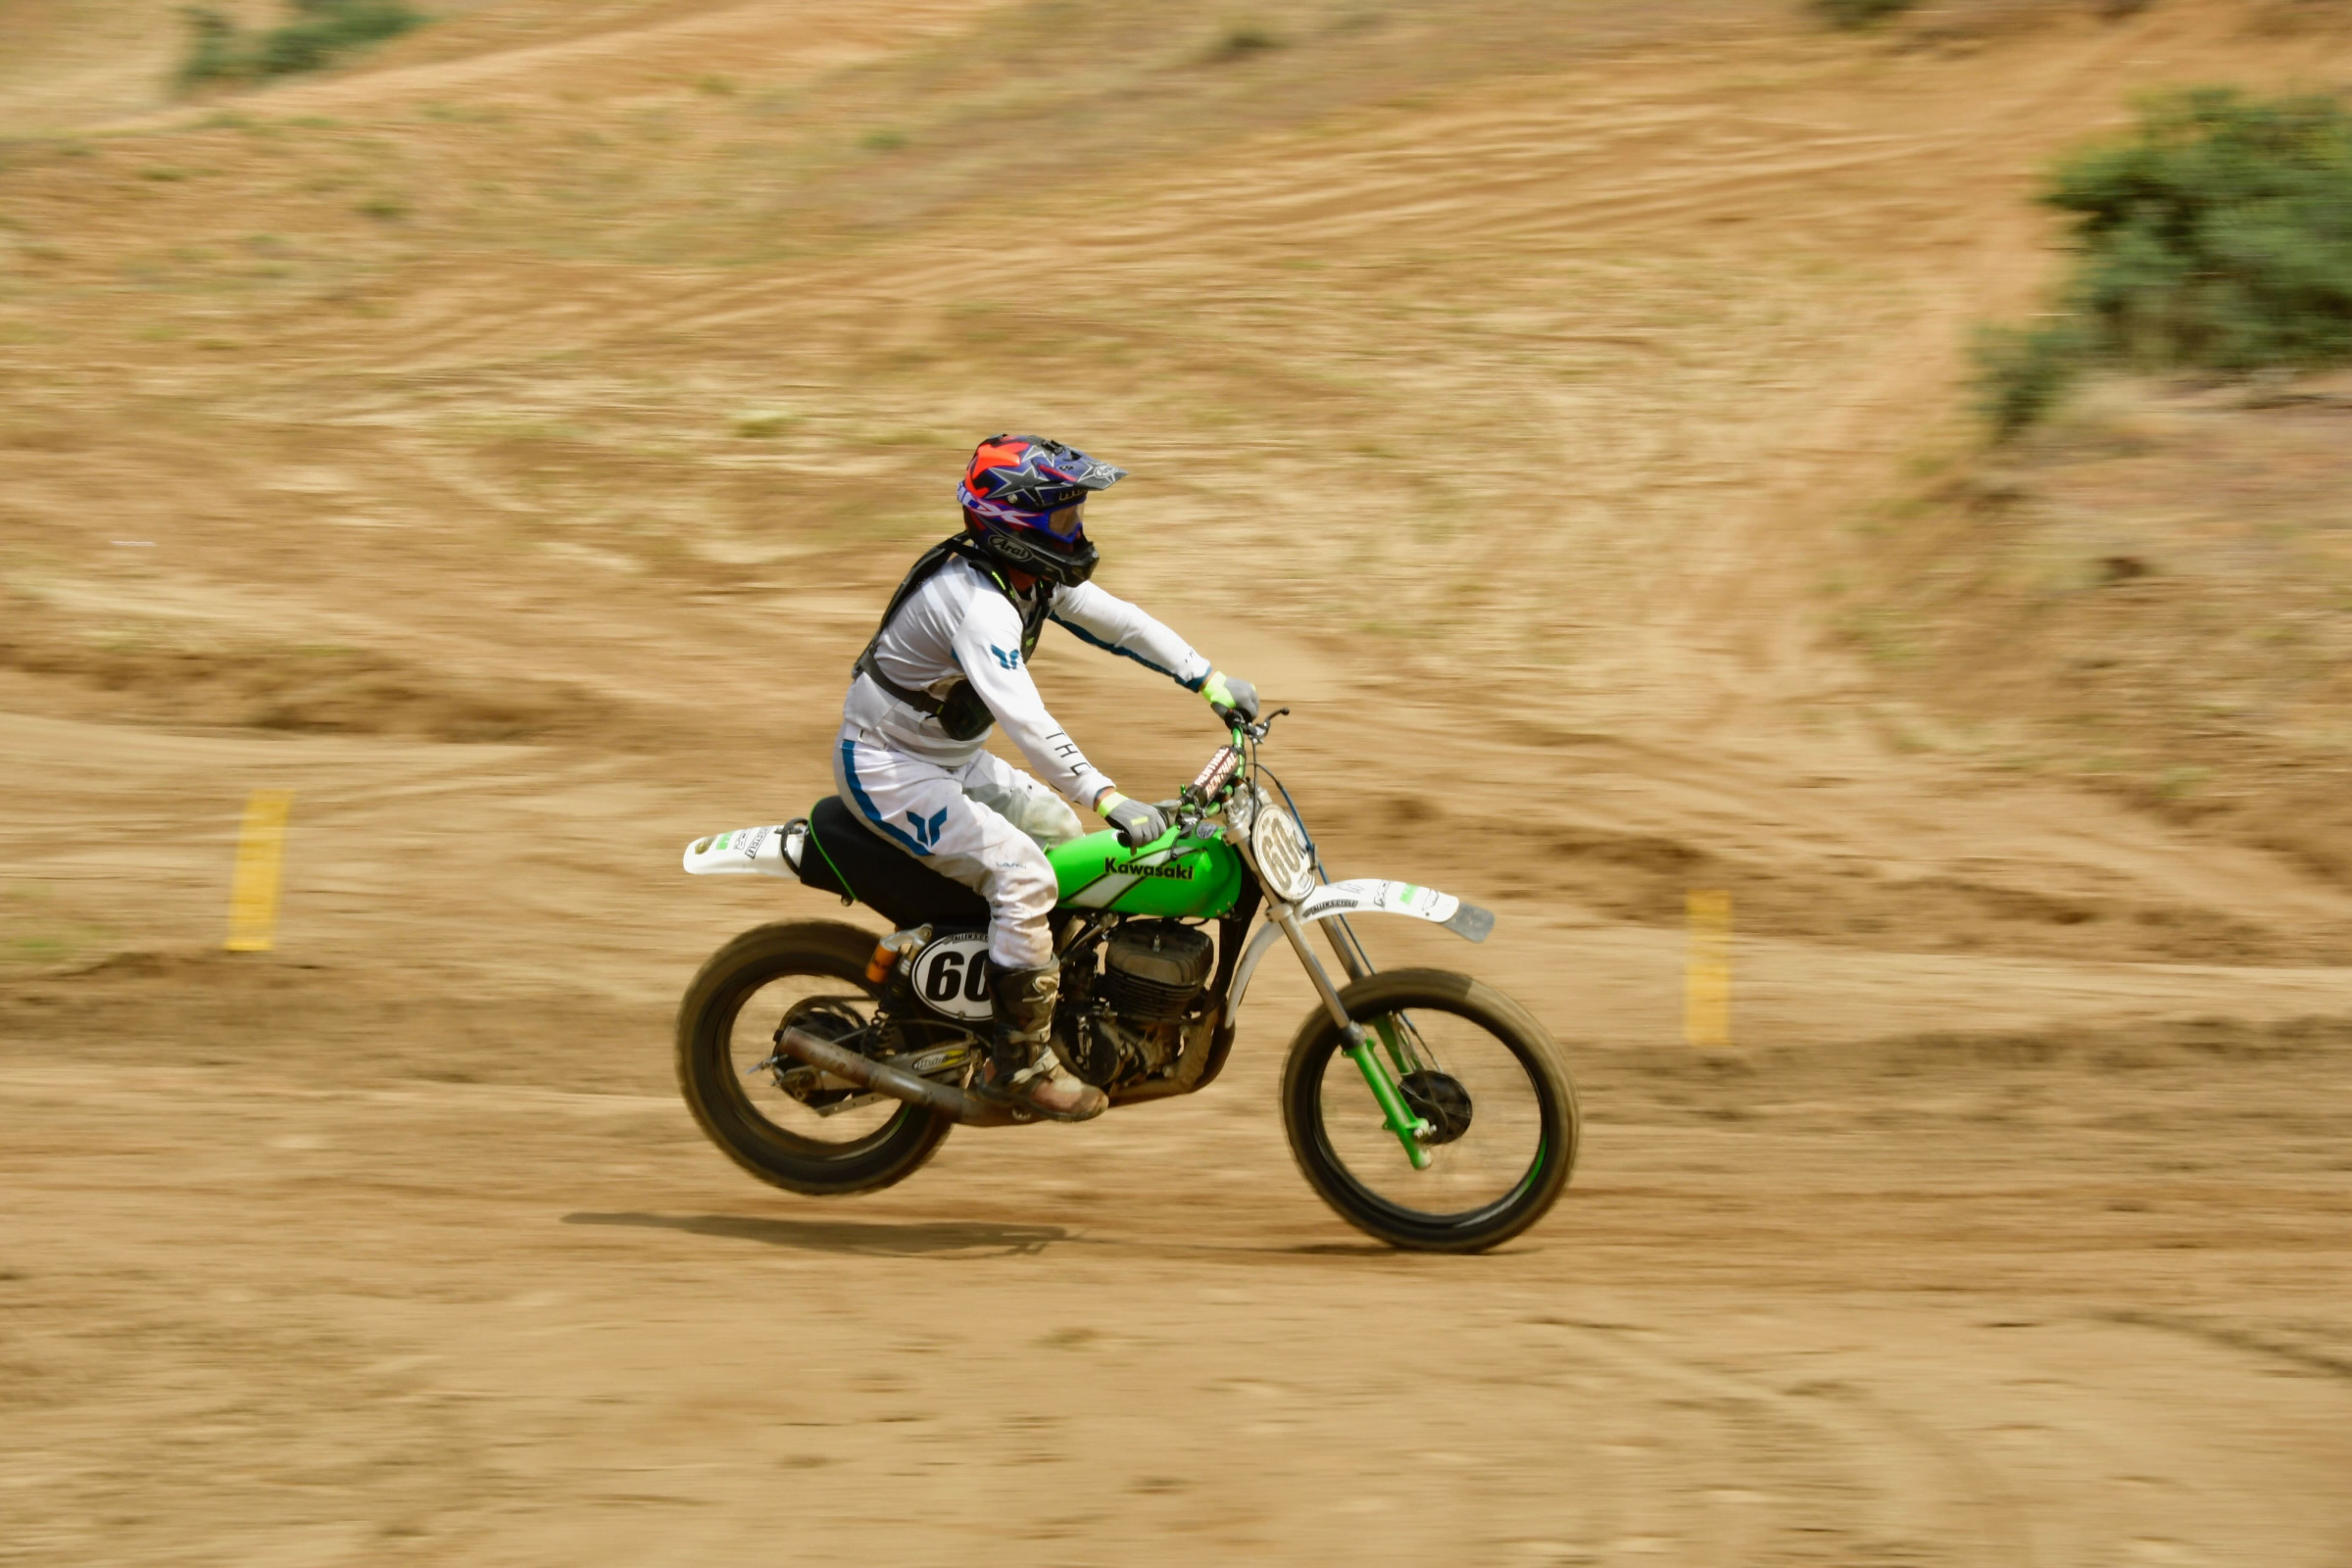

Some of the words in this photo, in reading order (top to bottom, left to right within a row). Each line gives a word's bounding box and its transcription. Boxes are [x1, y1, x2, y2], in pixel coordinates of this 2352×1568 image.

[994, 540, 1028, 558] Arai
[1104, 857, 1194, 880] Kawasaki
[925, 951, 992, 1003] 60
